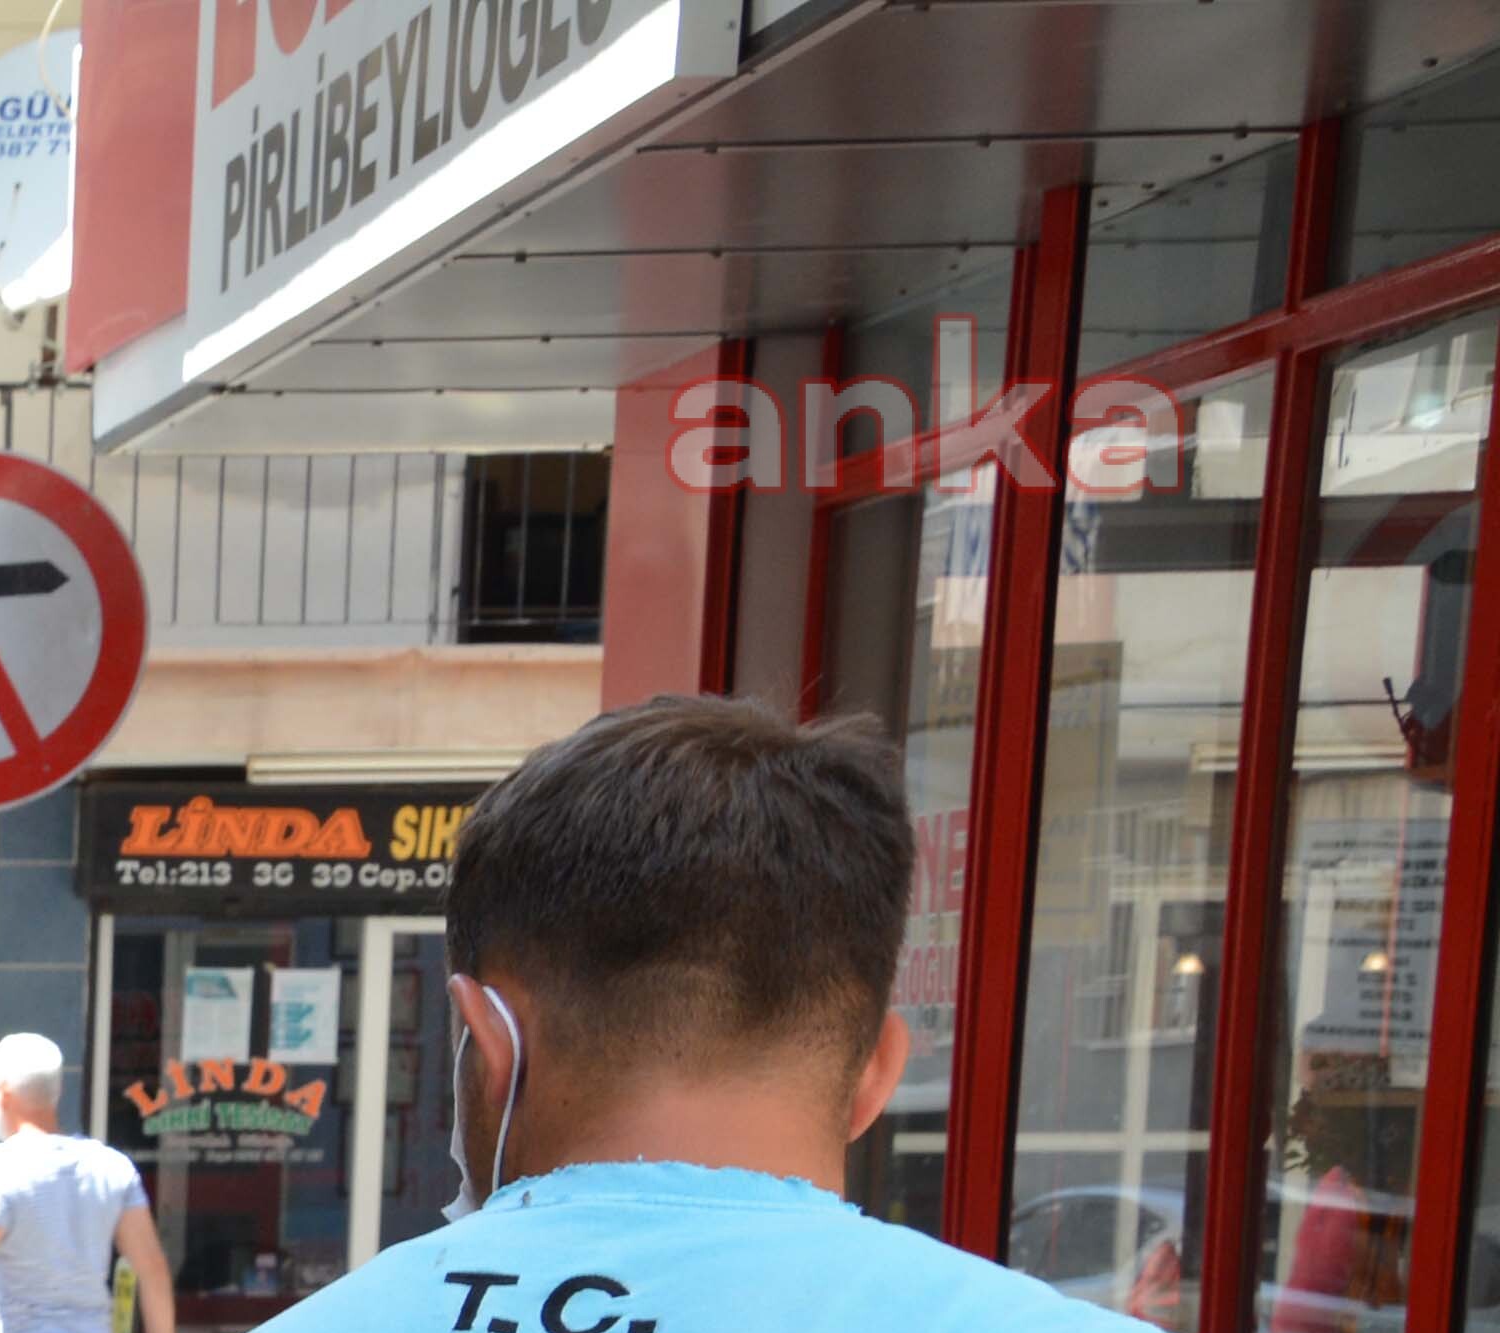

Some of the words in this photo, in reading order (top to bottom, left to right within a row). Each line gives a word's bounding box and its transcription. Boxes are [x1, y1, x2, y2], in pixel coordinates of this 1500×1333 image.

[120, 796, 372, 858] LİNDA
[389, 805, 476, 861] SIH
[116, 860, 232, 886] Tel:213
[253, 861, 294, 887] 36
[311, 862, 353, 887] 39
